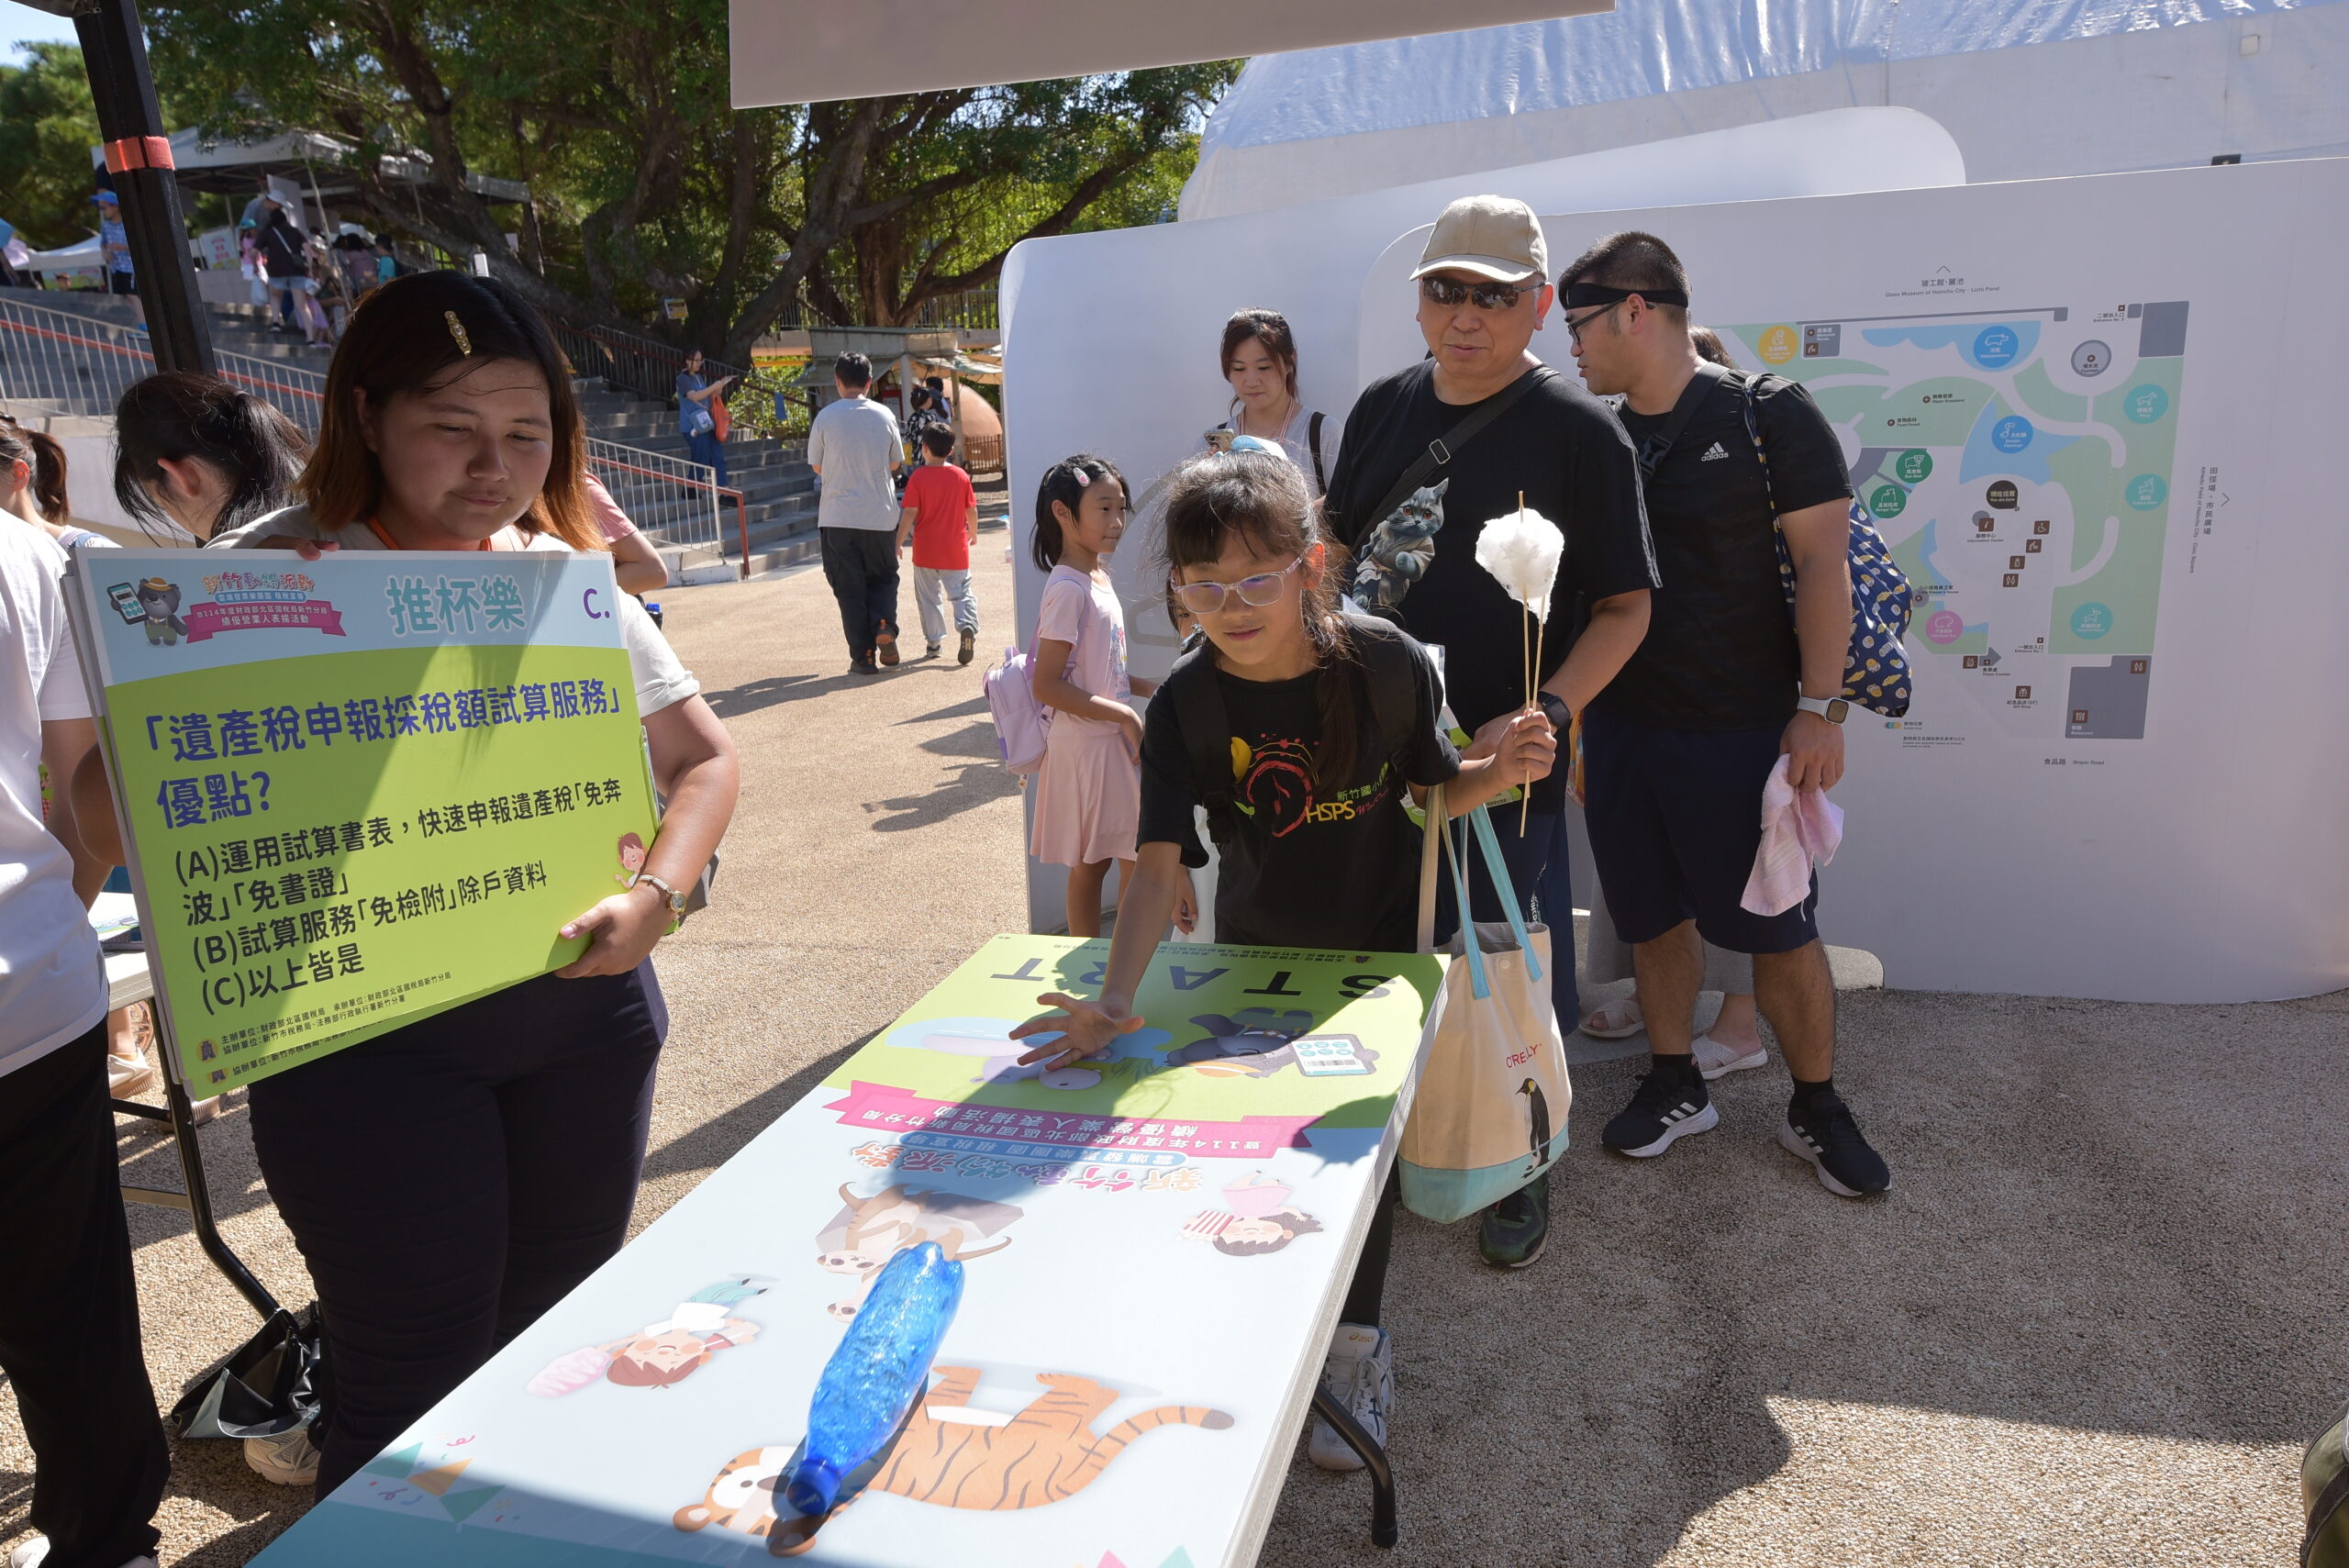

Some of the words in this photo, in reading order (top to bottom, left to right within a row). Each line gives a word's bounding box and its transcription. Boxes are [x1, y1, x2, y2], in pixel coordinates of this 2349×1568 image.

[1700, 451, 1730, 462] adidas
[386, 574, 524, 635] 推杯樂
[582, 588, 610, 620] C.
[145, 677, 621, 762] 「遺產稅申報採稅額試算服務」
[157, 771, 273, 828] 優點?
[1306, 799, 1356, 824] HSPS
[184, 878, 351, 927] 波」「免書證」
[202, 942, 365, 1015] (C)以上皆是
